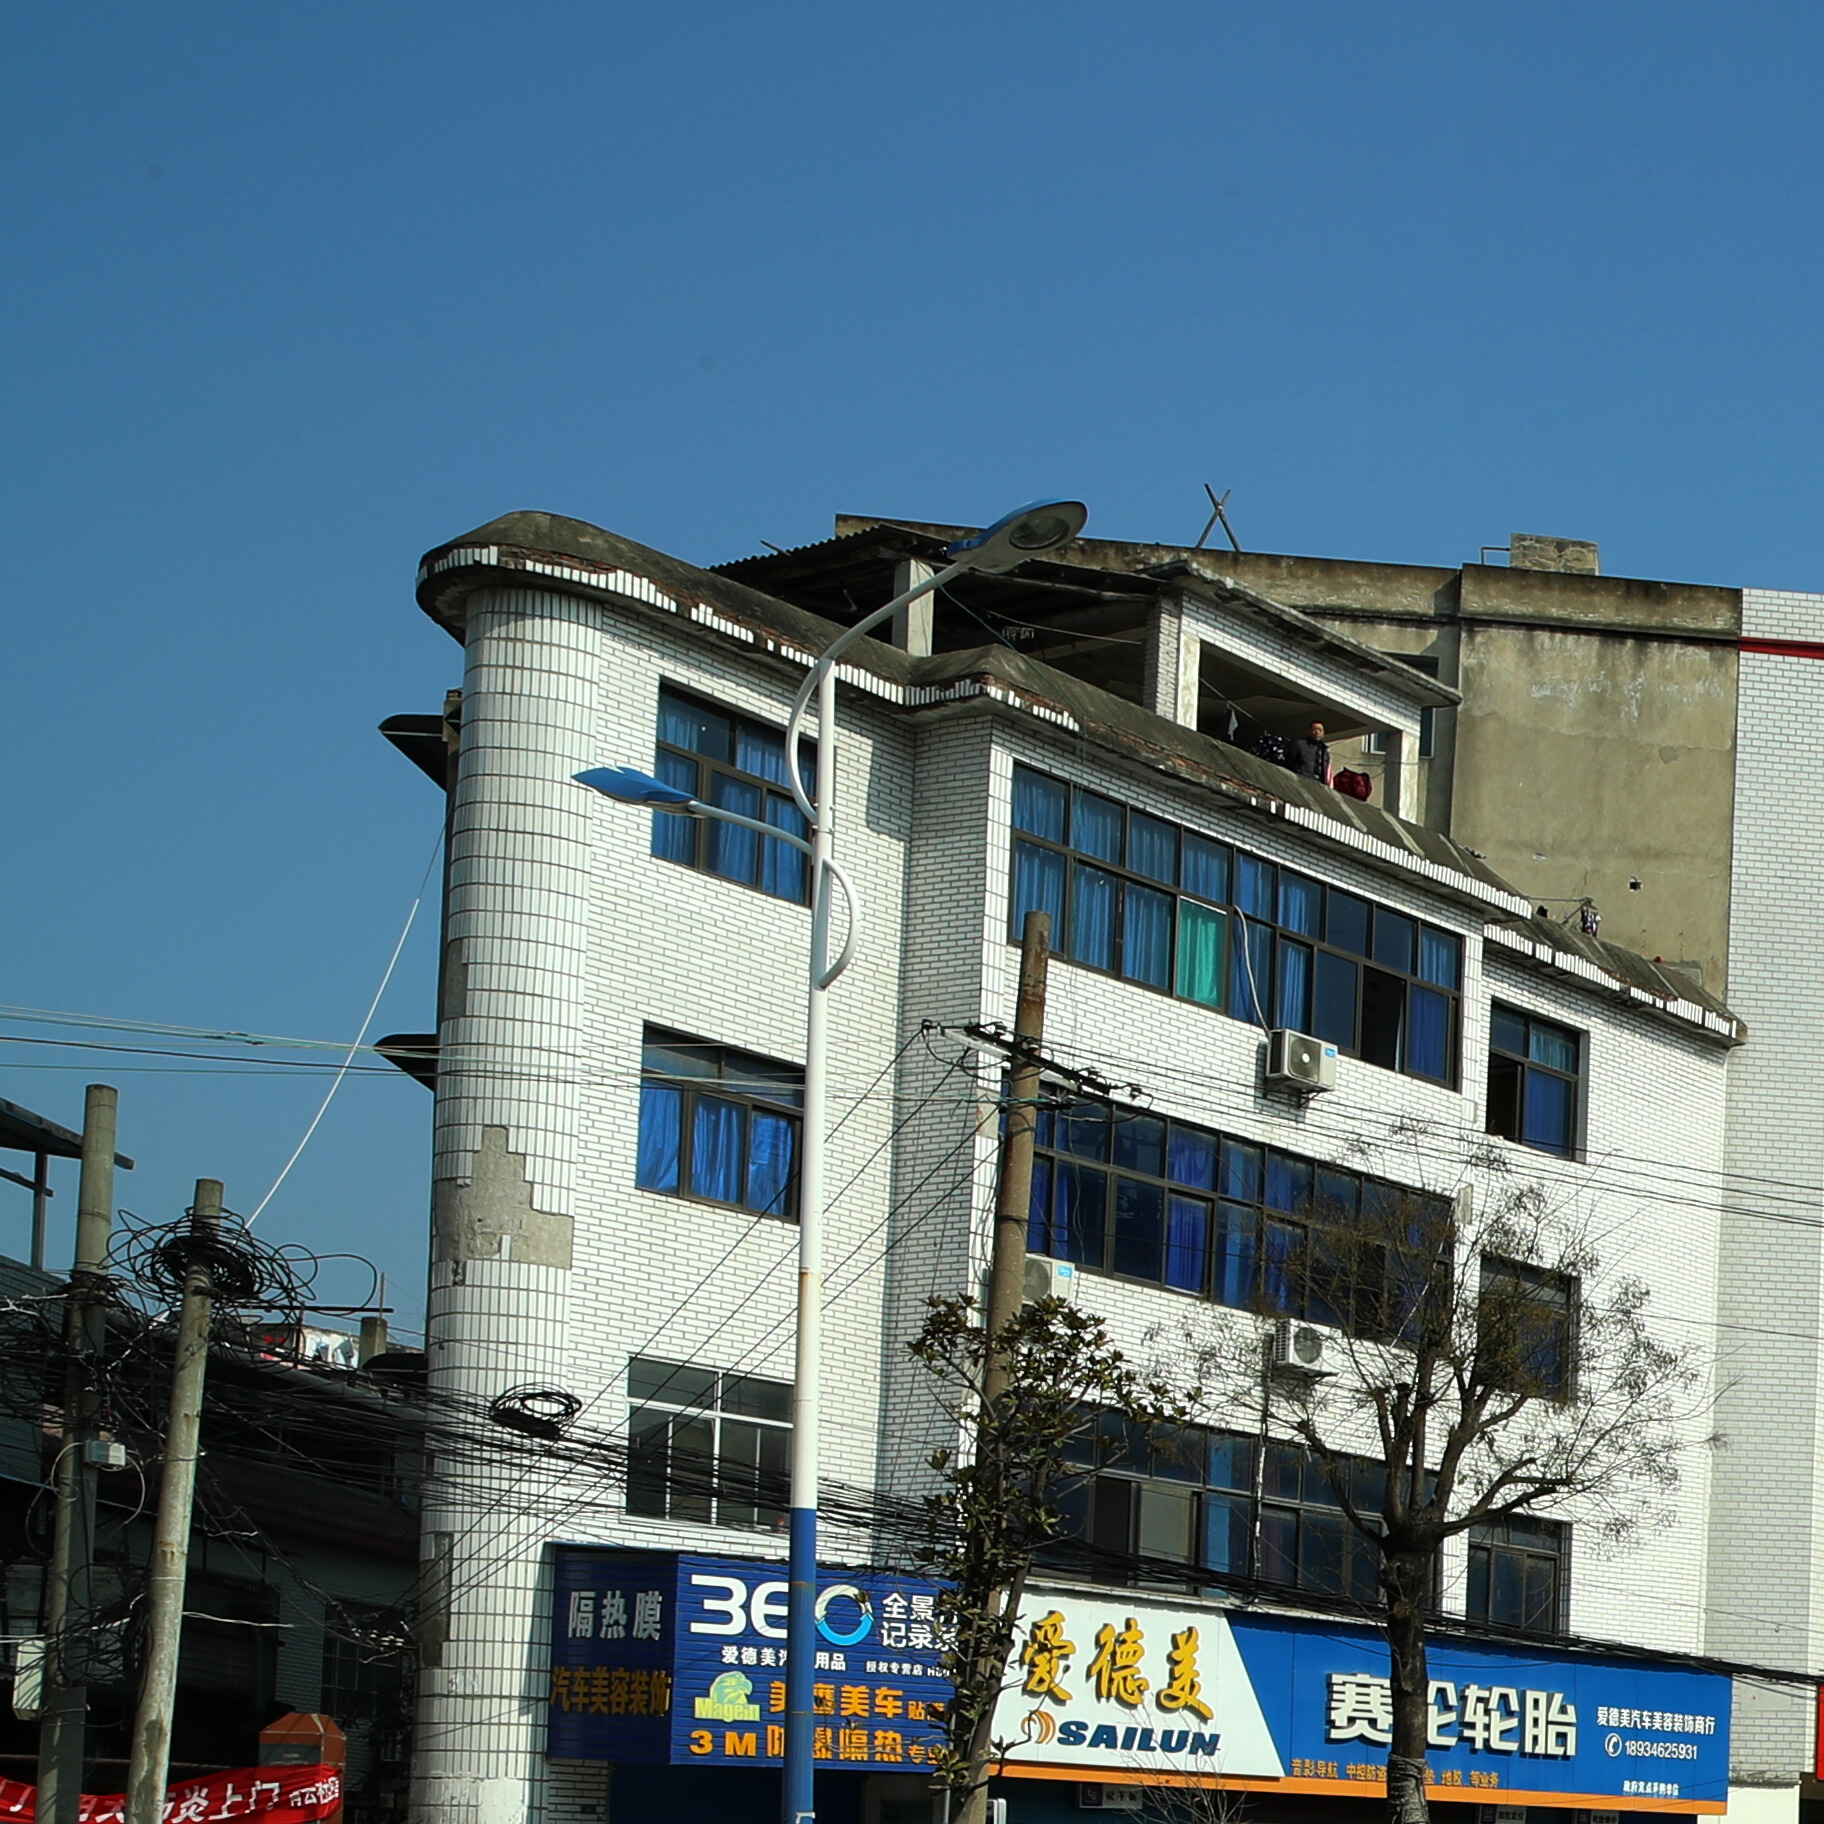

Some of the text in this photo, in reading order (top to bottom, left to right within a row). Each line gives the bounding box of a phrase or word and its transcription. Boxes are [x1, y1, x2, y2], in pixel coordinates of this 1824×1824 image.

[567, 1590, 663, 1642] 隔热膜
[721, 1645, 847, 1671] 爱德美汽用品
[866, 1660, 923, 1676] 授权专营店
[1021, 1610, 1214, 1722] 爱德美
[551, 1666, 672, 1718] 汽车美容装饰
[1597, 1706, 1716, 1735] 爱德美汽车美容装饰商行
[1057, 1720, 1221, 1757] SAILUN
[1624, 1740, 1698, 1760] 18934625931
